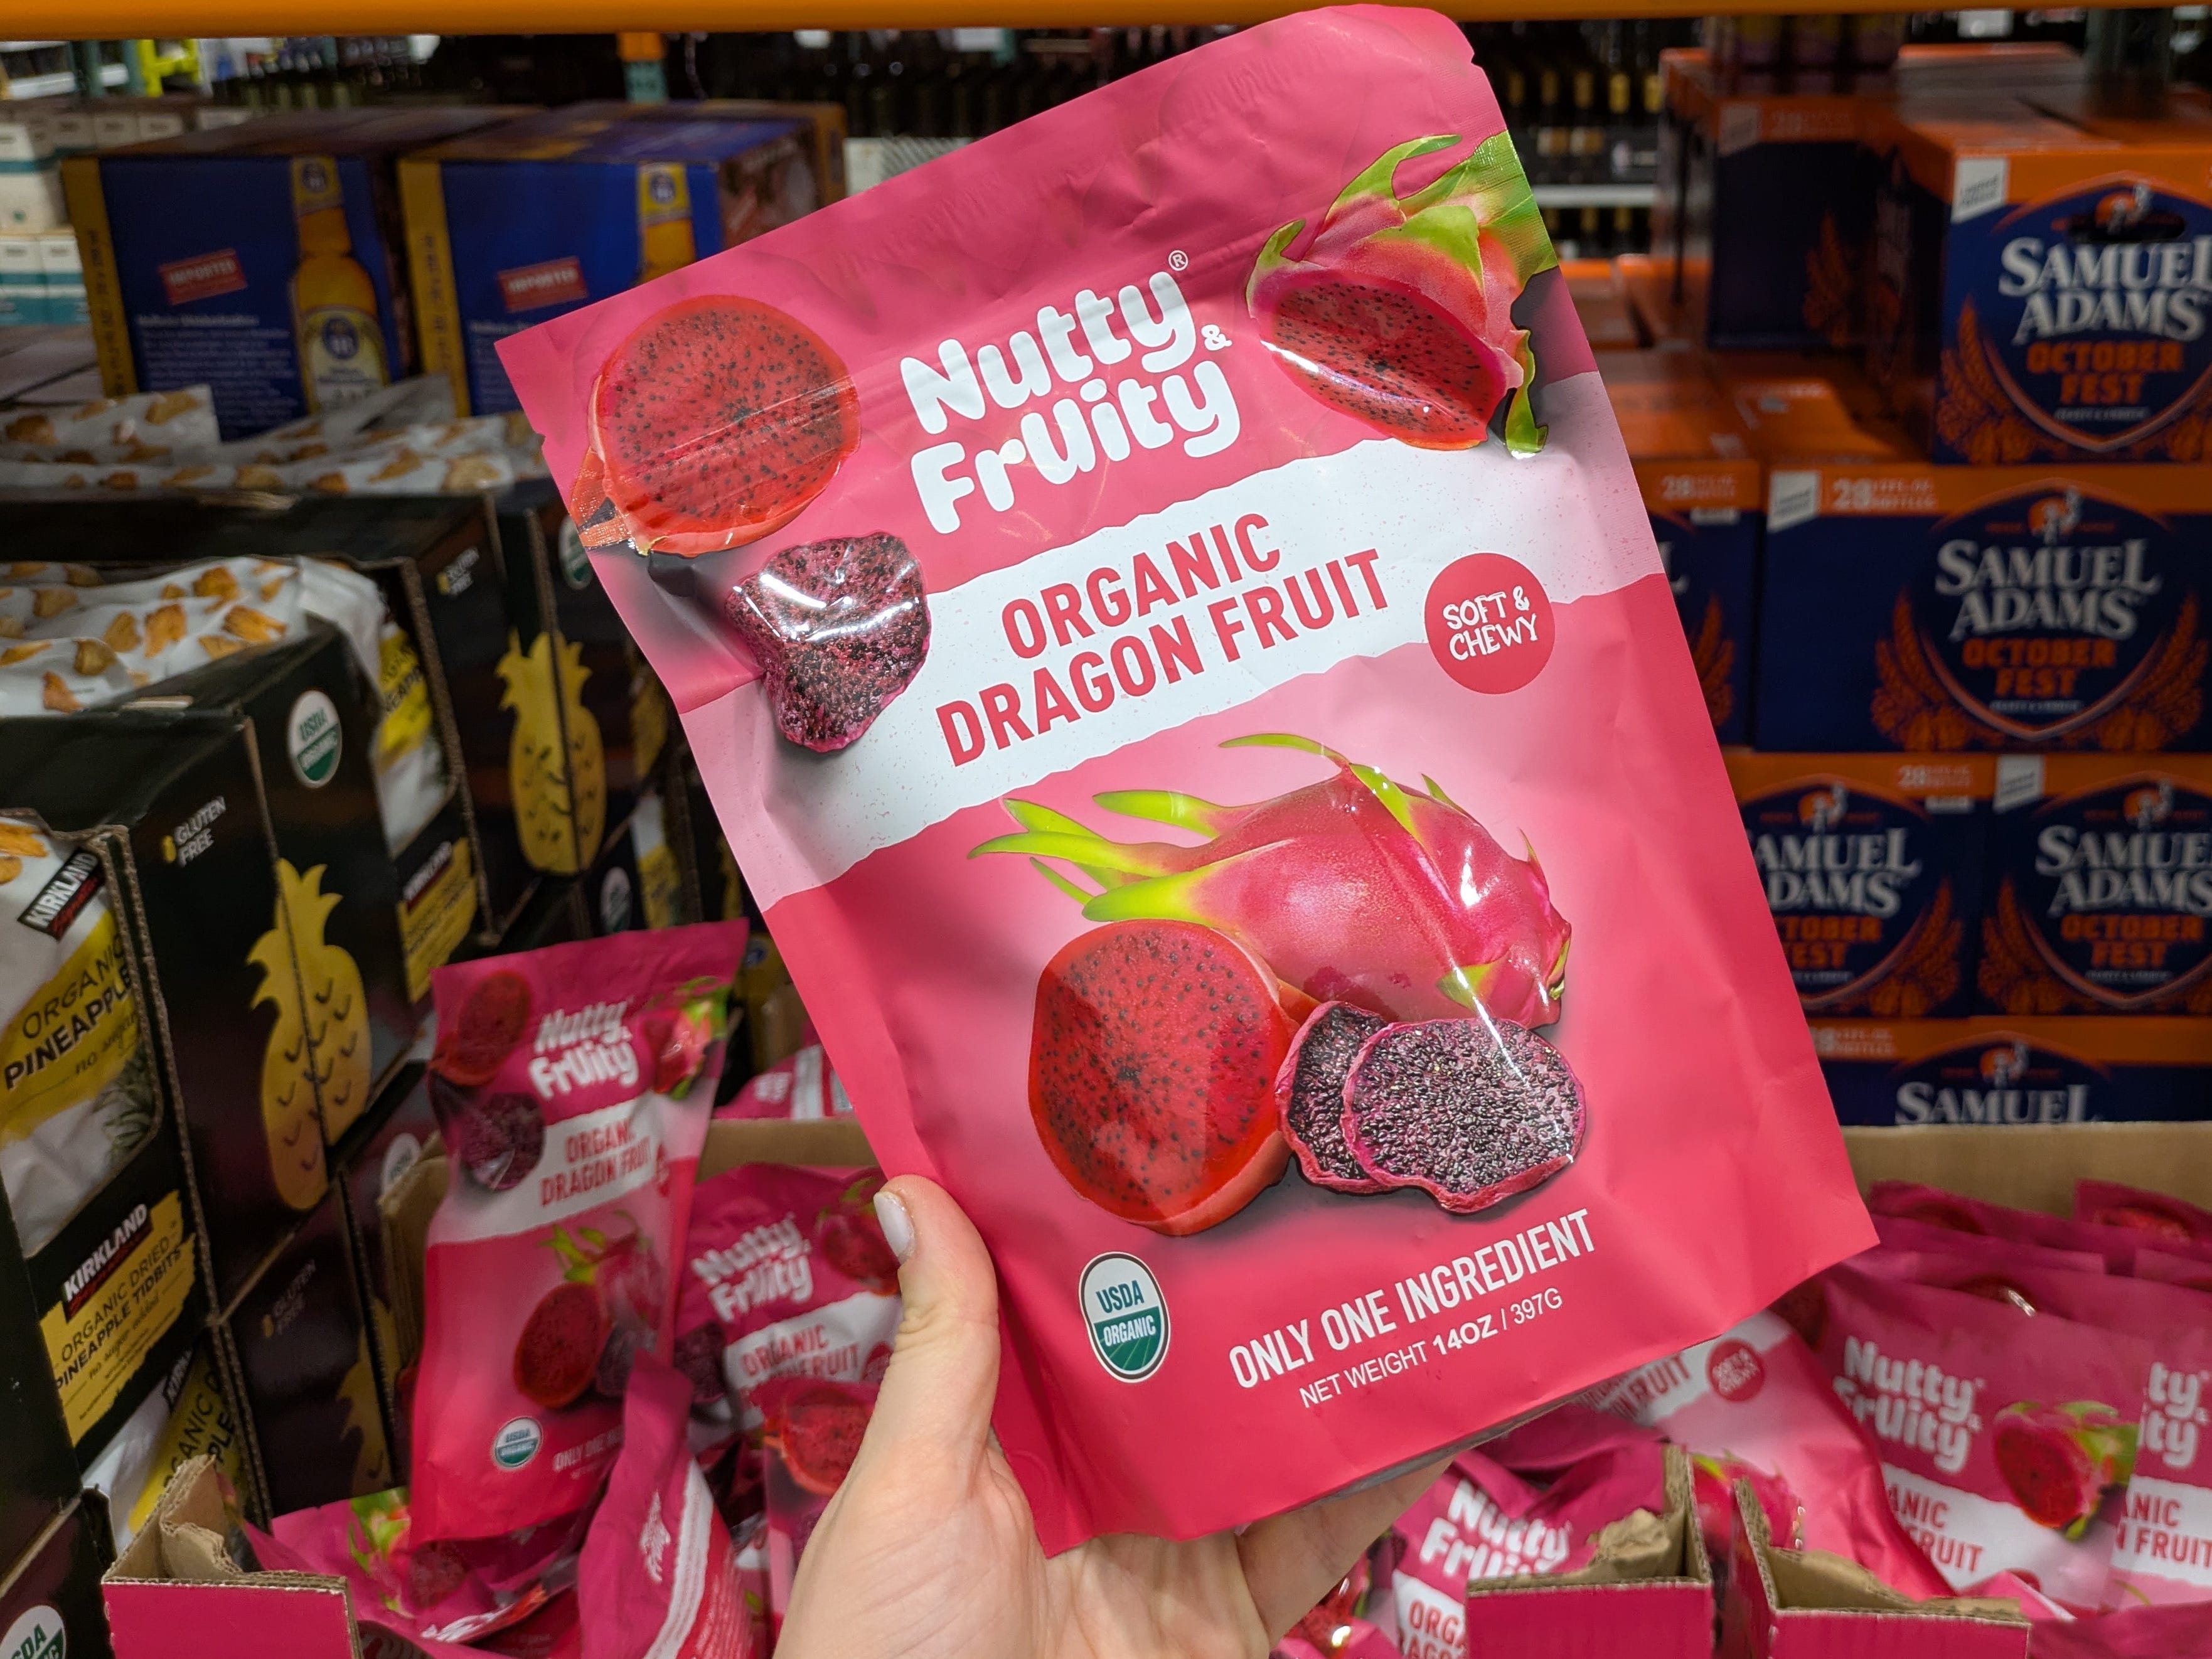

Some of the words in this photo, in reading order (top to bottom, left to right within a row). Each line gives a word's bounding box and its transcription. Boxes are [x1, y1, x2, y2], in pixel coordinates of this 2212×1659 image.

[1998, 235, 2212, 296] SAMUEL
[2011, 287, 2205, 345] ADAMS
[900, 271, 1197, 434] Nutty
[1201, 324, 1232, 351] &
[2026, 341, 2183, 375] OCTOBER
[2060, 375, 2144, 405] FEST
[1002, 513, 1281, 659] ORGANIC
[1935, 538, 2163, 596] SAMUEL
[1443, 590, 1507, 630] SOFT
[1512, 585, 1530, 611] &
[1947, 586, 2138, 642] ADAMS
[935, 614, 1204, 767] DRAGON
[1207, 548, 1387, 663] FRUIT
[1449, 612, 1538, 661] CHEWY
[1962, 637, 2117, 668] OCTOBER
[1995, 668, 2077, 698] FEST
[174, 796, 226, 846] GLUTEN
[178, 828, 214, 867] FREE
[1750, 828, 1923, 878] AMUEL
[2035, 824, 2212, 877] SAMUE
[24, 851, 99, 927] KIRKLAND
[1766, 870, 1901, 918] DAMS
[2046, 870, 2212, 919] ADAMS
[1773, 915, 1881, 944] TOBER
[2060, 914, 2203, 941] OCTOBER
[2091, 942, 2166, 968] FEST
[22, 931, 125, 1039] ORGANIC
[4, 962, 132, 1091] PINEAPPLE
[534, 1000, 627, 1054] Nutty
[564, 1115, 631, 1165] ORGAN
[541, 1153, 617, 1208] DRAGON
[63, 1203, 147, 1303] KIRKLAND
[692, 1216, 803, 1286] Nutty
[55, 1305, 132, 1390] PINEAPPLE
[132, 1247, 182, 1304] TIDBITS
[62, 1283, 128, 1362] ORGANIC
[129, 1235, 169, 1286] DRIED
[1095, 1279, 1145, 1313] USDA
[1228, 1318, 1315, 1389] ONLY
[1320, 1288, 1398, 1351] ONE
[1394, 1208, 1596, 1324] INGREDIENT
[1103, 1315, 1157, 1347] ORGANIC
[1299, 1373, 1342, 1408] NET
[1344, 1341, 1429, 1389] WEIGHT
[1432, 1314, 1498, 1355] 14OZ
[1510, 1287, 1563, 1325] 397G
[802, 1342, 860, 1377] RUIT
[1628, 1352, 1692, 1409] RUIT
[1844, 1335, 1974, 1423] Nutty
[1447, 1478, 1569, 1574] Nutty
[1888, 1482, 1950, 1528] ANIC
[1419, 1517, 1532, 1581] Fru
[2135, 1525, 2212, 1568] FRUIT
